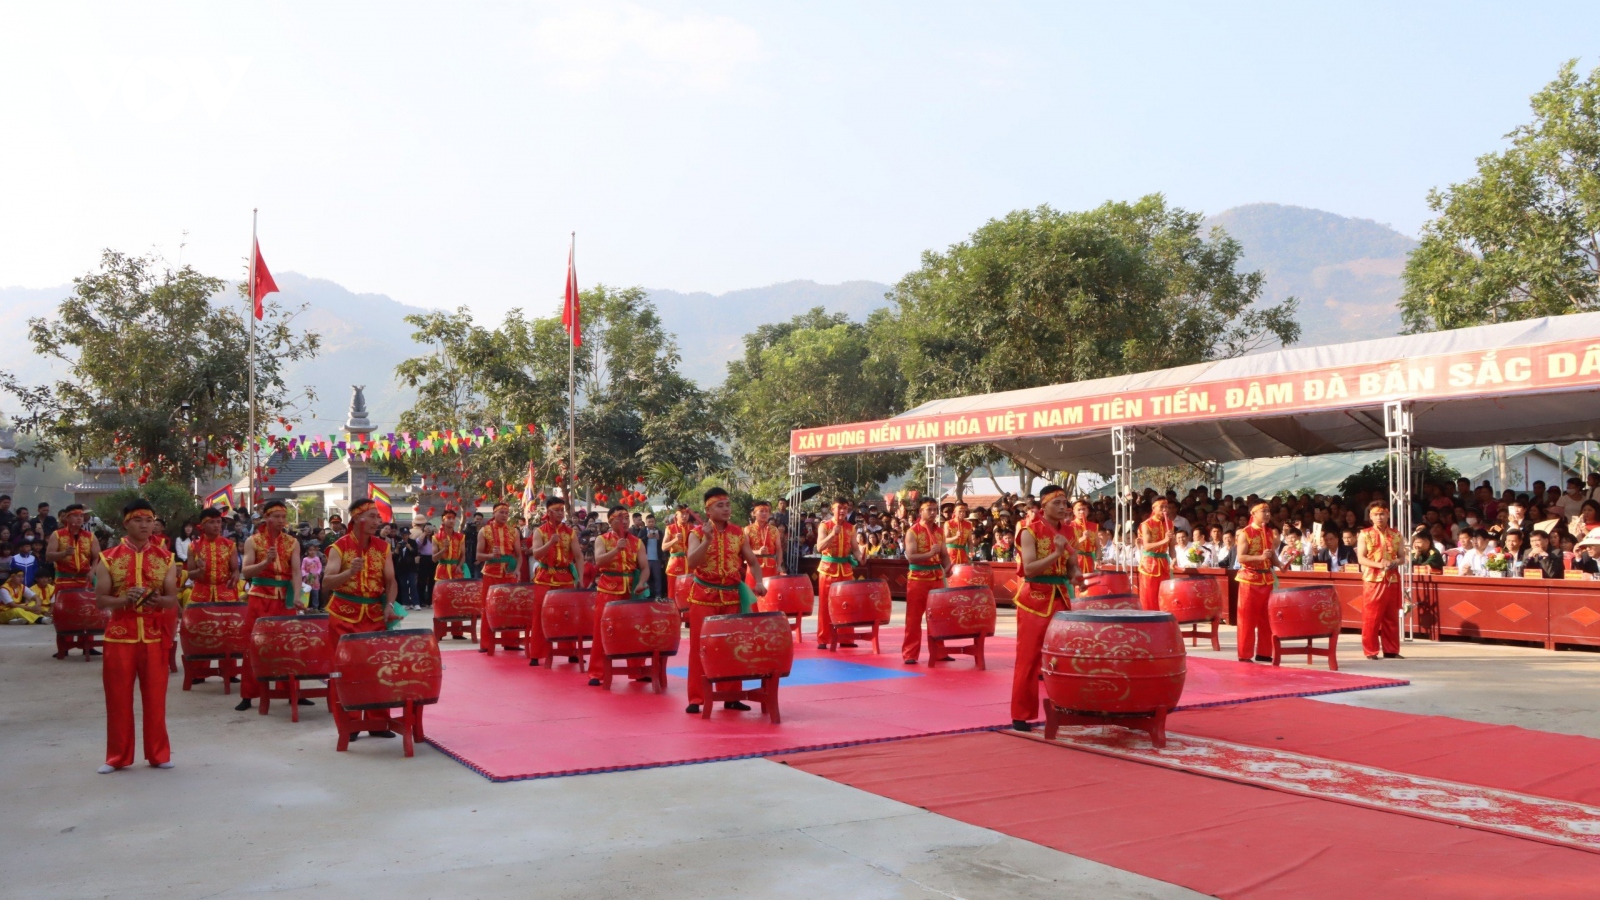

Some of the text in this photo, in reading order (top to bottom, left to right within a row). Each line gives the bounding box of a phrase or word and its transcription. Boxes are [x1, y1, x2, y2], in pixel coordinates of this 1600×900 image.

[798, 432, 823, 449] XÂY
[827, 429, 865, 450] DỰNG
[869, 422, 901, 443] NỀN
[905, 420, 939, 440] VĂN
[944, 415, 981, 436] HÓA
[985, 410, 1027, 434] VIỆT
[1033, 405, 1083, 428] NAM
[1090, 397, 1143, 422] TIÊN
[1149, 387, 1216, 416] TIẾN,
[1225, 381, 1293, 411] ĐẬM
[1303, 372, 1348, 401] ĐÀ
[1359, 363, 1435, 396] BẢN
[1448, 351, 1532, 387] SẮC
